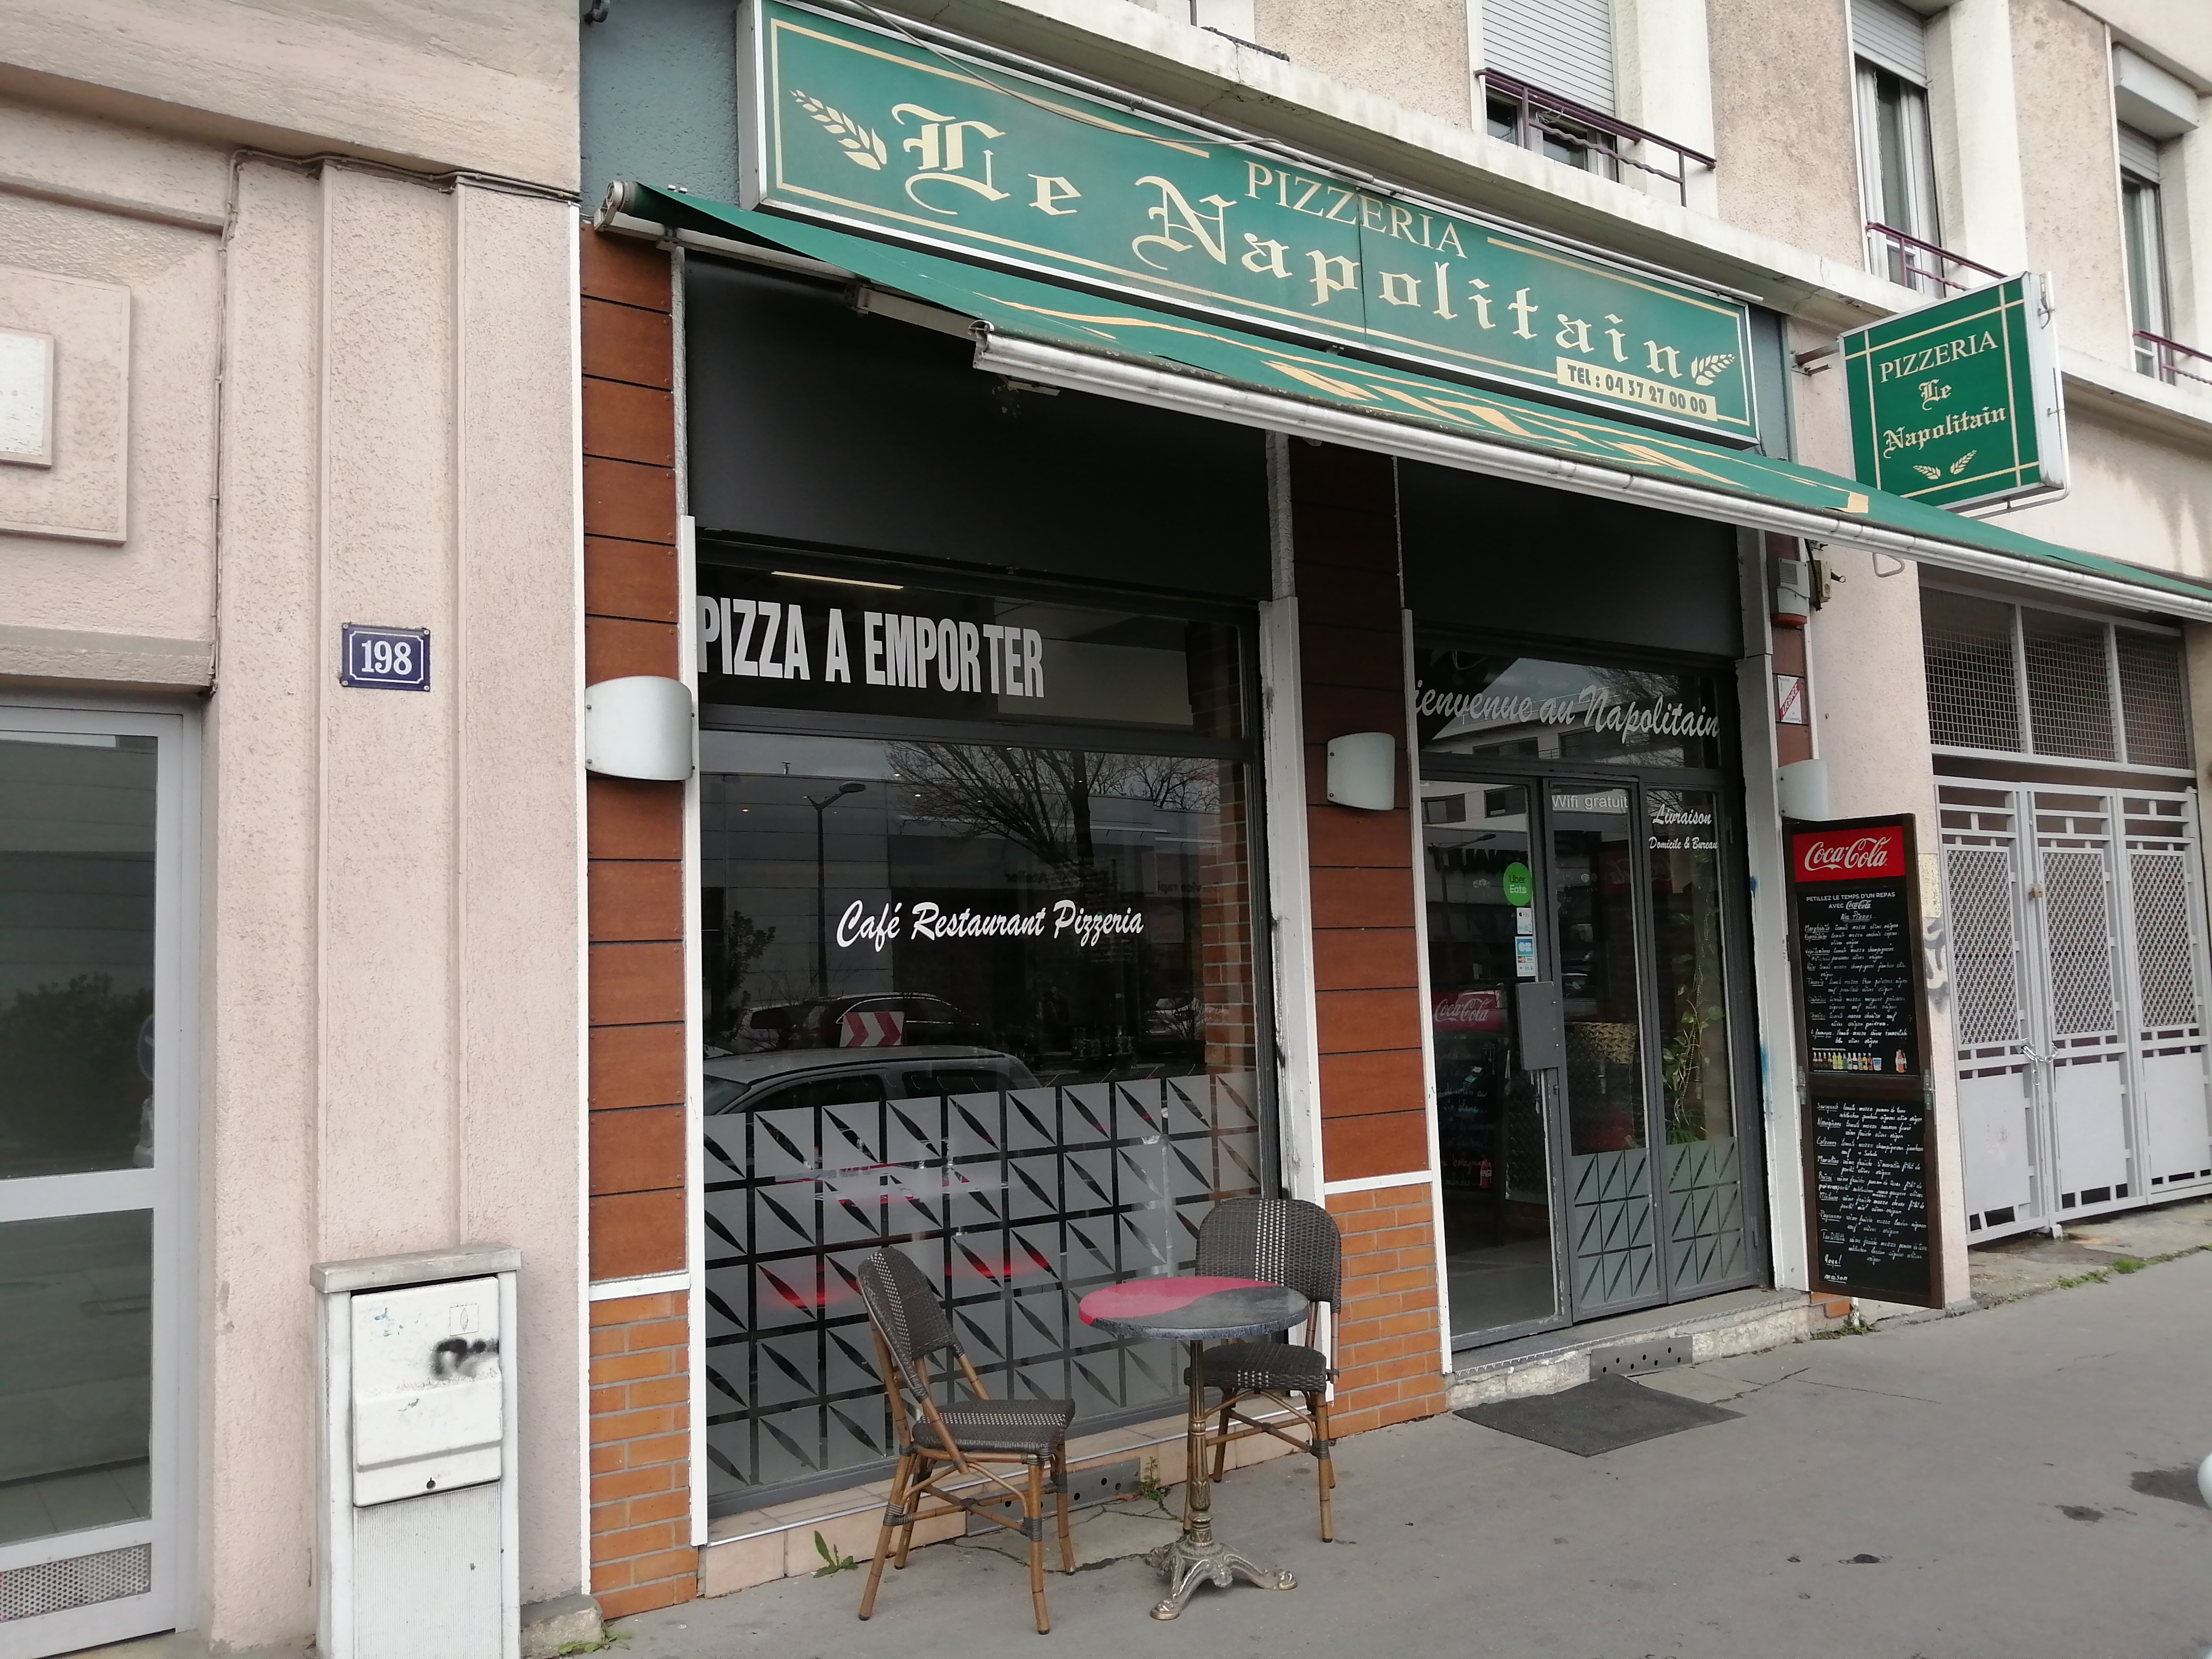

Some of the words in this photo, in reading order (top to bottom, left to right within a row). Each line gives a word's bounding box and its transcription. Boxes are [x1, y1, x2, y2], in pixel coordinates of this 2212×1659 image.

[1243, 159, 1469, 259] PIZZERIA
[891, 103, 1082, 215] Le
[1131, 175, 1683, 379] Napolitain
[1879, 330, 1999, 383] PIZZERIA
[1605, 374, 1623, 393] 04
[1628, 379, 1644, 398] 37
[1649, 385, 1664, 404] 27
[1669, 391, 1686, 409] 00
[1690, 396, 1707, 414] 00
[1918, 379, 1952, 410] Le
[1883, 406, 2007, 459] Napolitain
[361, 640, 413, 675] 198
[697, 596, 810, 681] PIZZA
[825, 608, 851, 683] A
[864, 611, 1044, 698] EMPORTER
[1415, 679, 1532, 722] ienvenue
[1539, 698, 1576, 725] au
[1579, 684, 1720, 744] Napolitain
[1782, 683, 1798, 715] LICENCE
[1552, 795, 1578, 808] Wifi
[1584, 796, 1628, 810] gratuit
[1652, 803, 1712, 825] Livraison
[1649, 836, 1681, 849] Domicile
[1683, 836, 1690, 849] &
[1692, 836, 1717, 849] Bureau
[1804, 836, 1892, 871] Coca-Cola
[1509, 875, 1526, 883] Uber
[1510, 885, 1527, 894] Eats
[836, 900, 902, 952] Café
[911, 901, 1046, 940] Restaurant
[1053, 899, 1144, 946] Pizzeria
